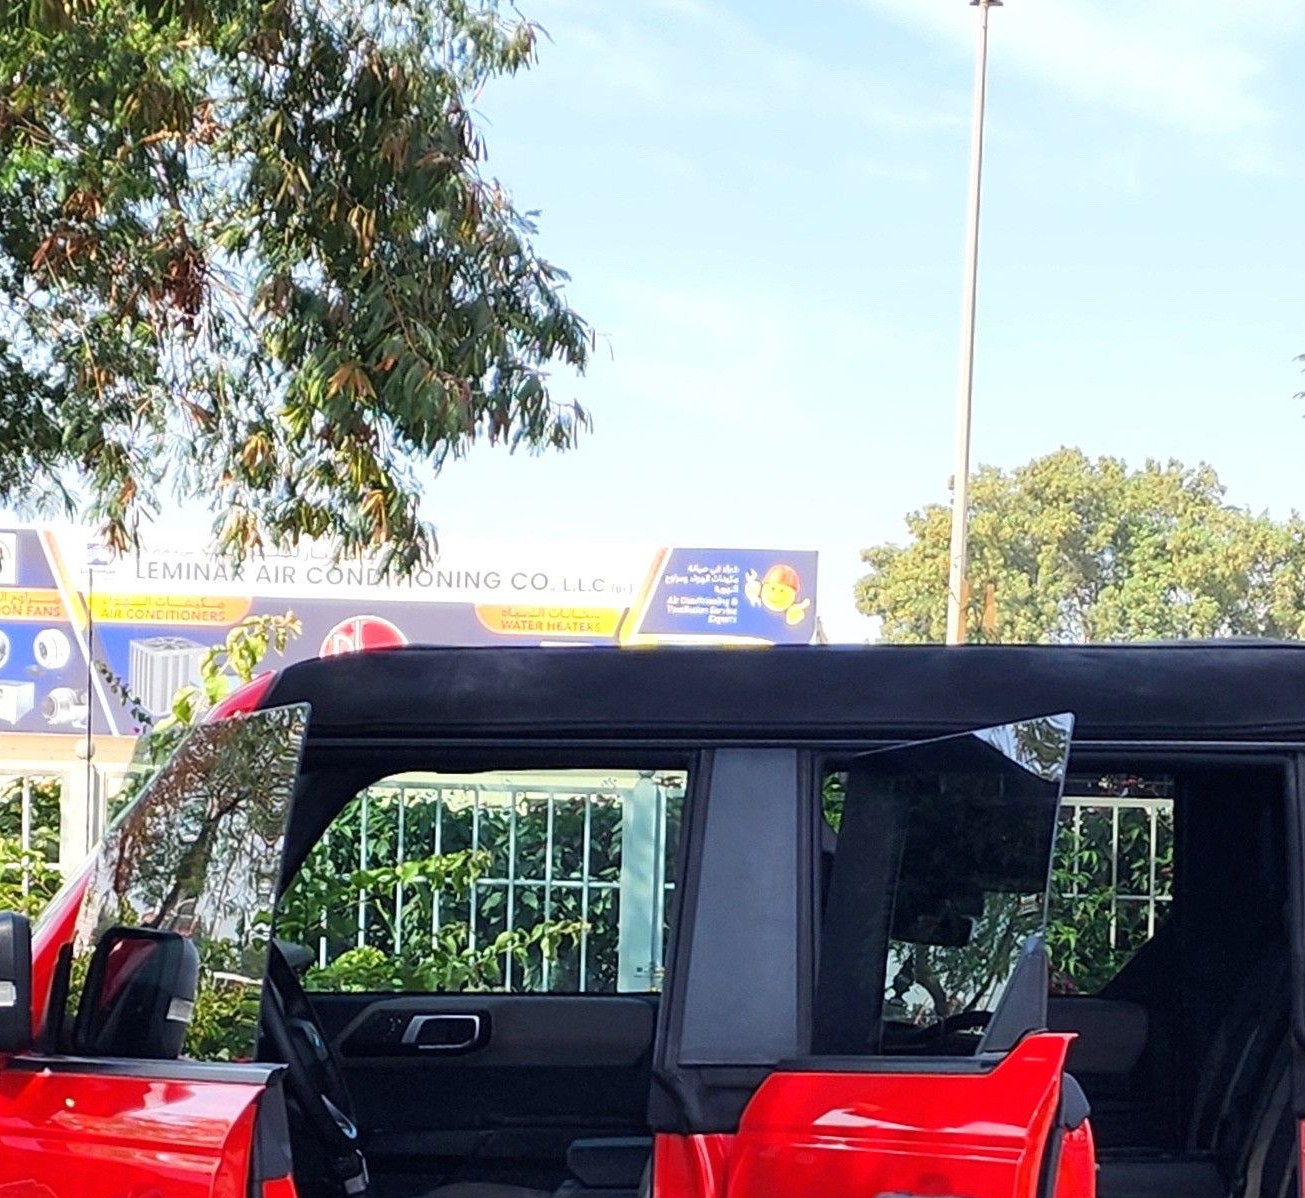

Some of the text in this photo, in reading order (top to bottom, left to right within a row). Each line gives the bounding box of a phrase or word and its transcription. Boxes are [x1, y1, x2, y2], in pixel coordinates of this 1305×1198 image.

[136, 561, 245, 583] LEMINAR
[256, 564, 296, 584] AIR
[563, 577, 606, 593] L.L.C
[26, 606, 61, 617] FANS
[126, 609, 226, 622] CONDITIONERS
[501, 620, 601, 633] WATER HEATERS
